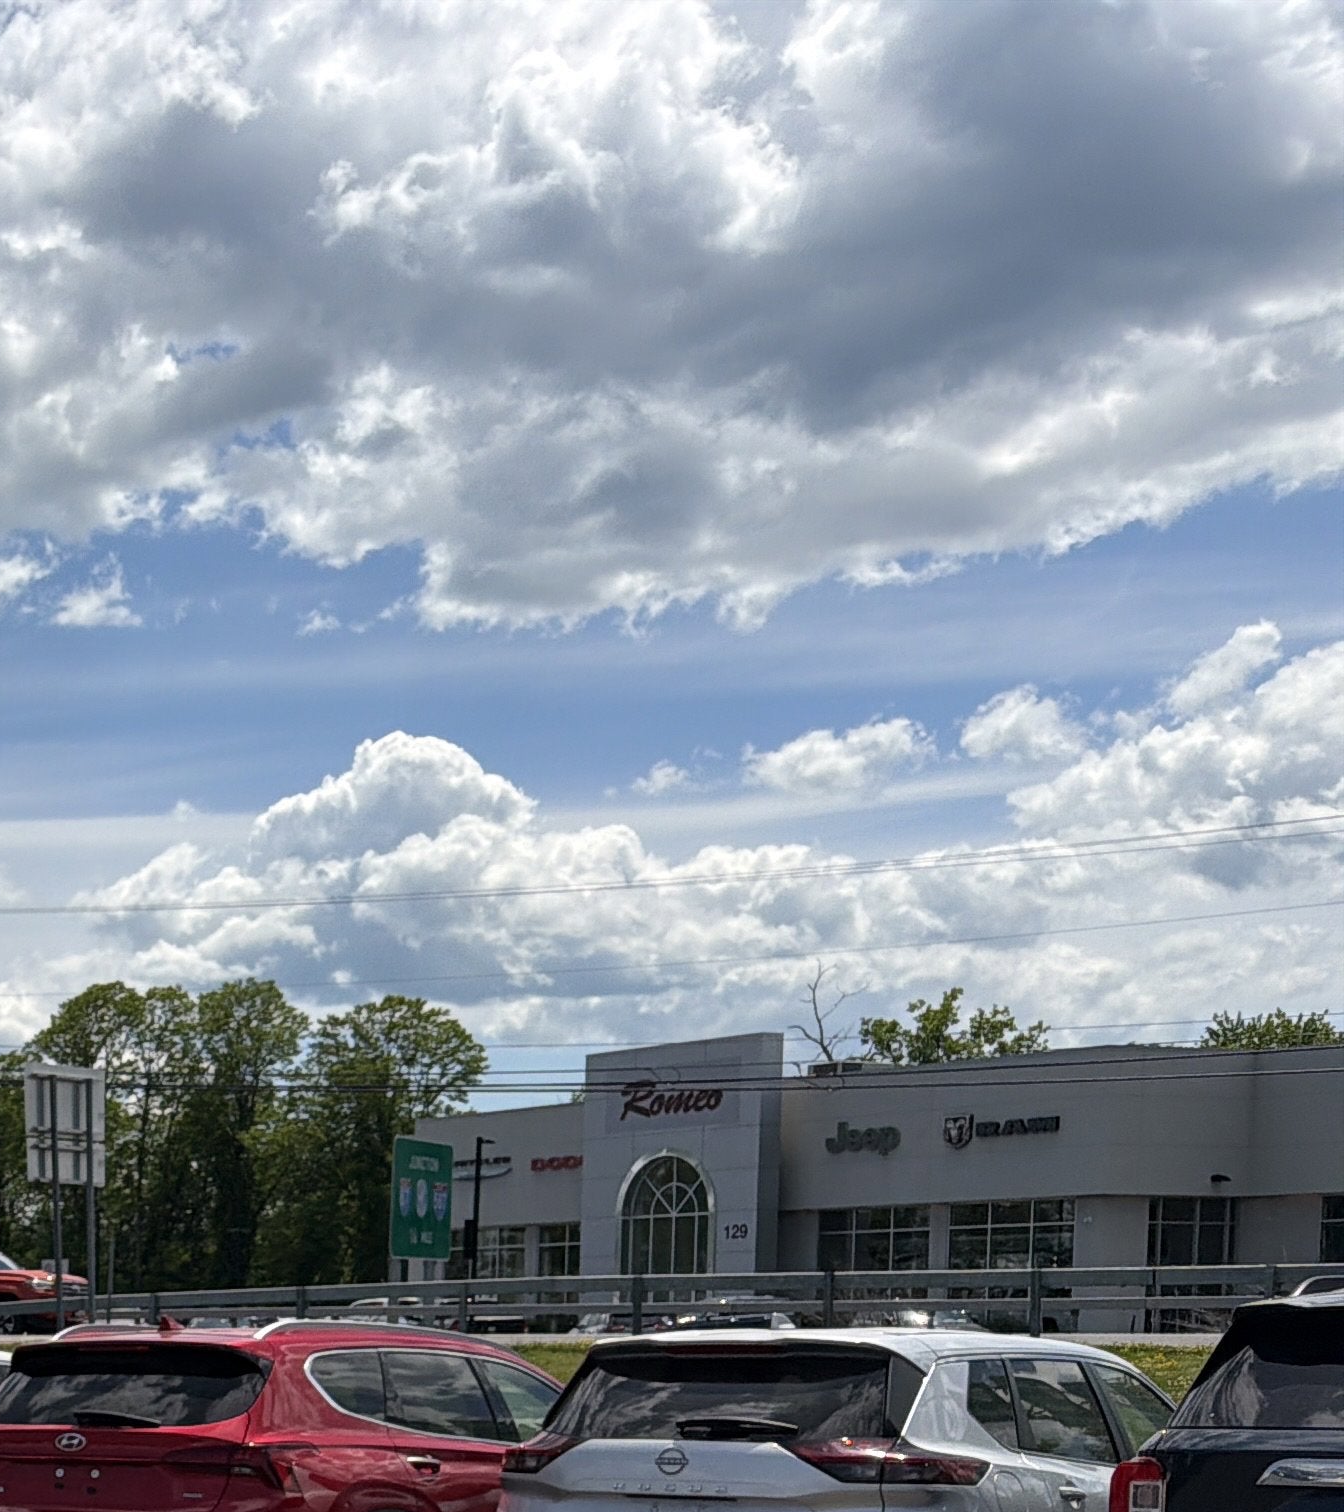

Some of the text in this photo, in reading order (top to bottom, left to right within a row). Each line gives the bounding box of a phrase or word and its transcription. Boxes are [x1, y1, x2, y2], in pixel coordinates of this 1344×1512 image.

[620, 1080, 724, 1121] Romeo
[531, 1154, 583, 1172] DOD
[724, 1223, 749, 1240] 129
